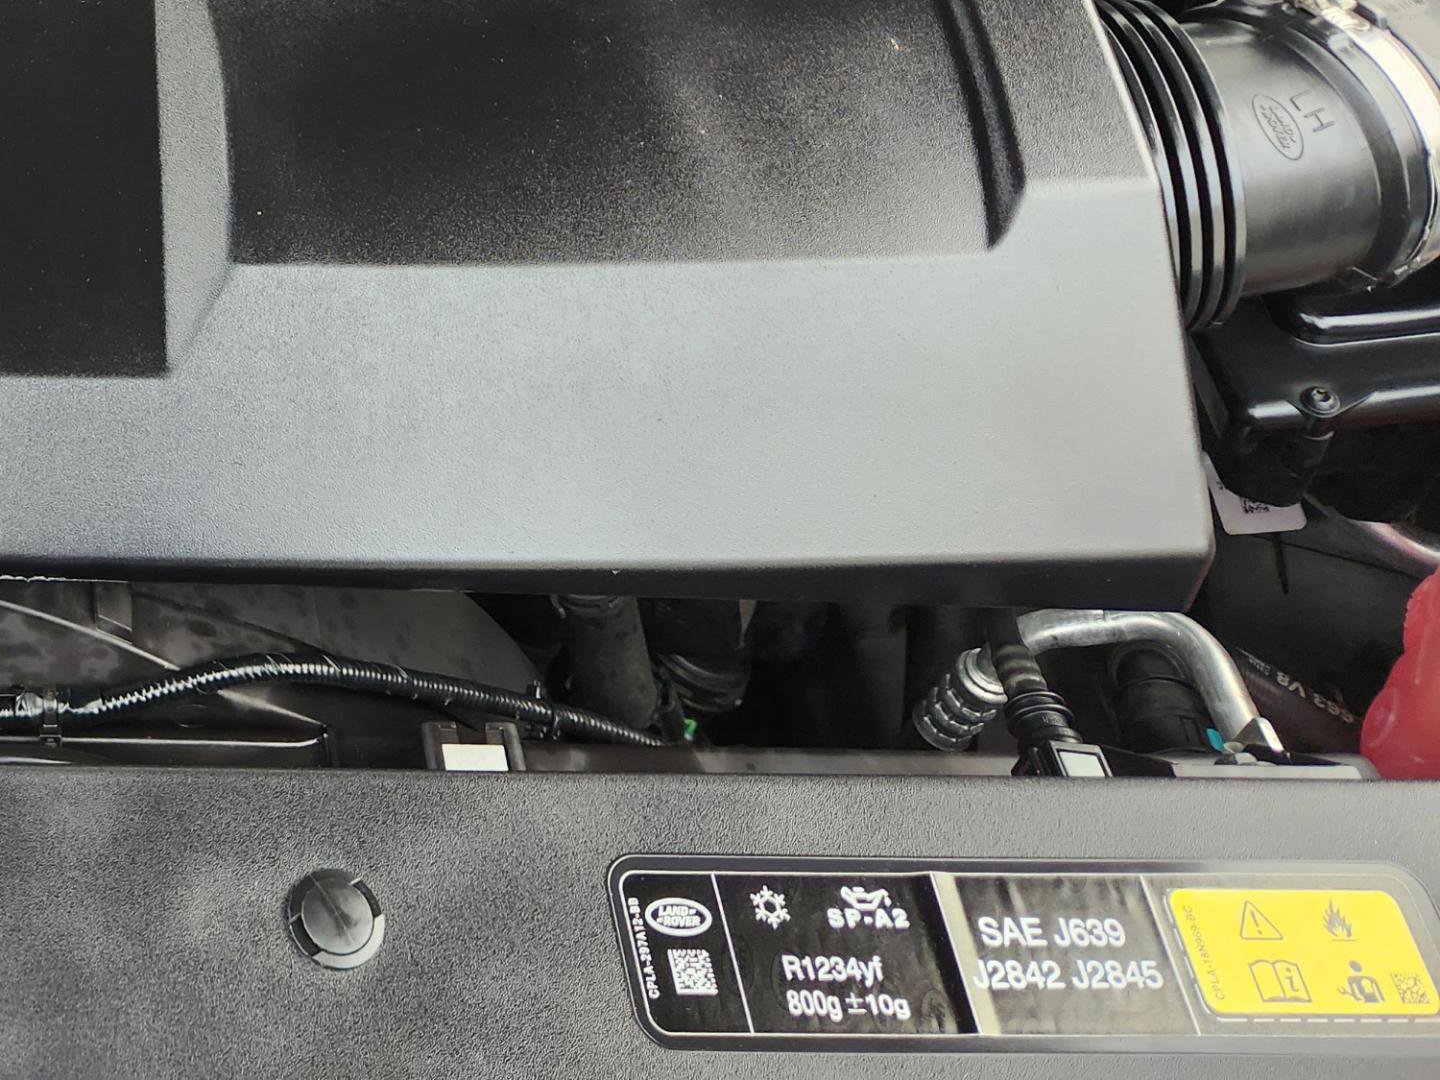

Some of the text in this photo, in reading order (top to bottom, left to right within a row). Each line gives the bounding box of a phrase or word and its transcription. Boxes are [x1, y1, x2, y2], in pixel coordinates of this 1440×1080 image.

[1290, 89, 1335, 133] LH
[1276, 671, 1307, 699] V8
[658, 905, 689, 917] LAND
[663, 915, 701, 928] ROVER
[826, 907, 911, 930] SP-A2
[978, 916, 1126, 948] SAE J639
[781, 954, 884, 989] R1234yf
[972, 959, 1165, 990] J2842 J2845
[786, 989, 844, 1023] 800g
